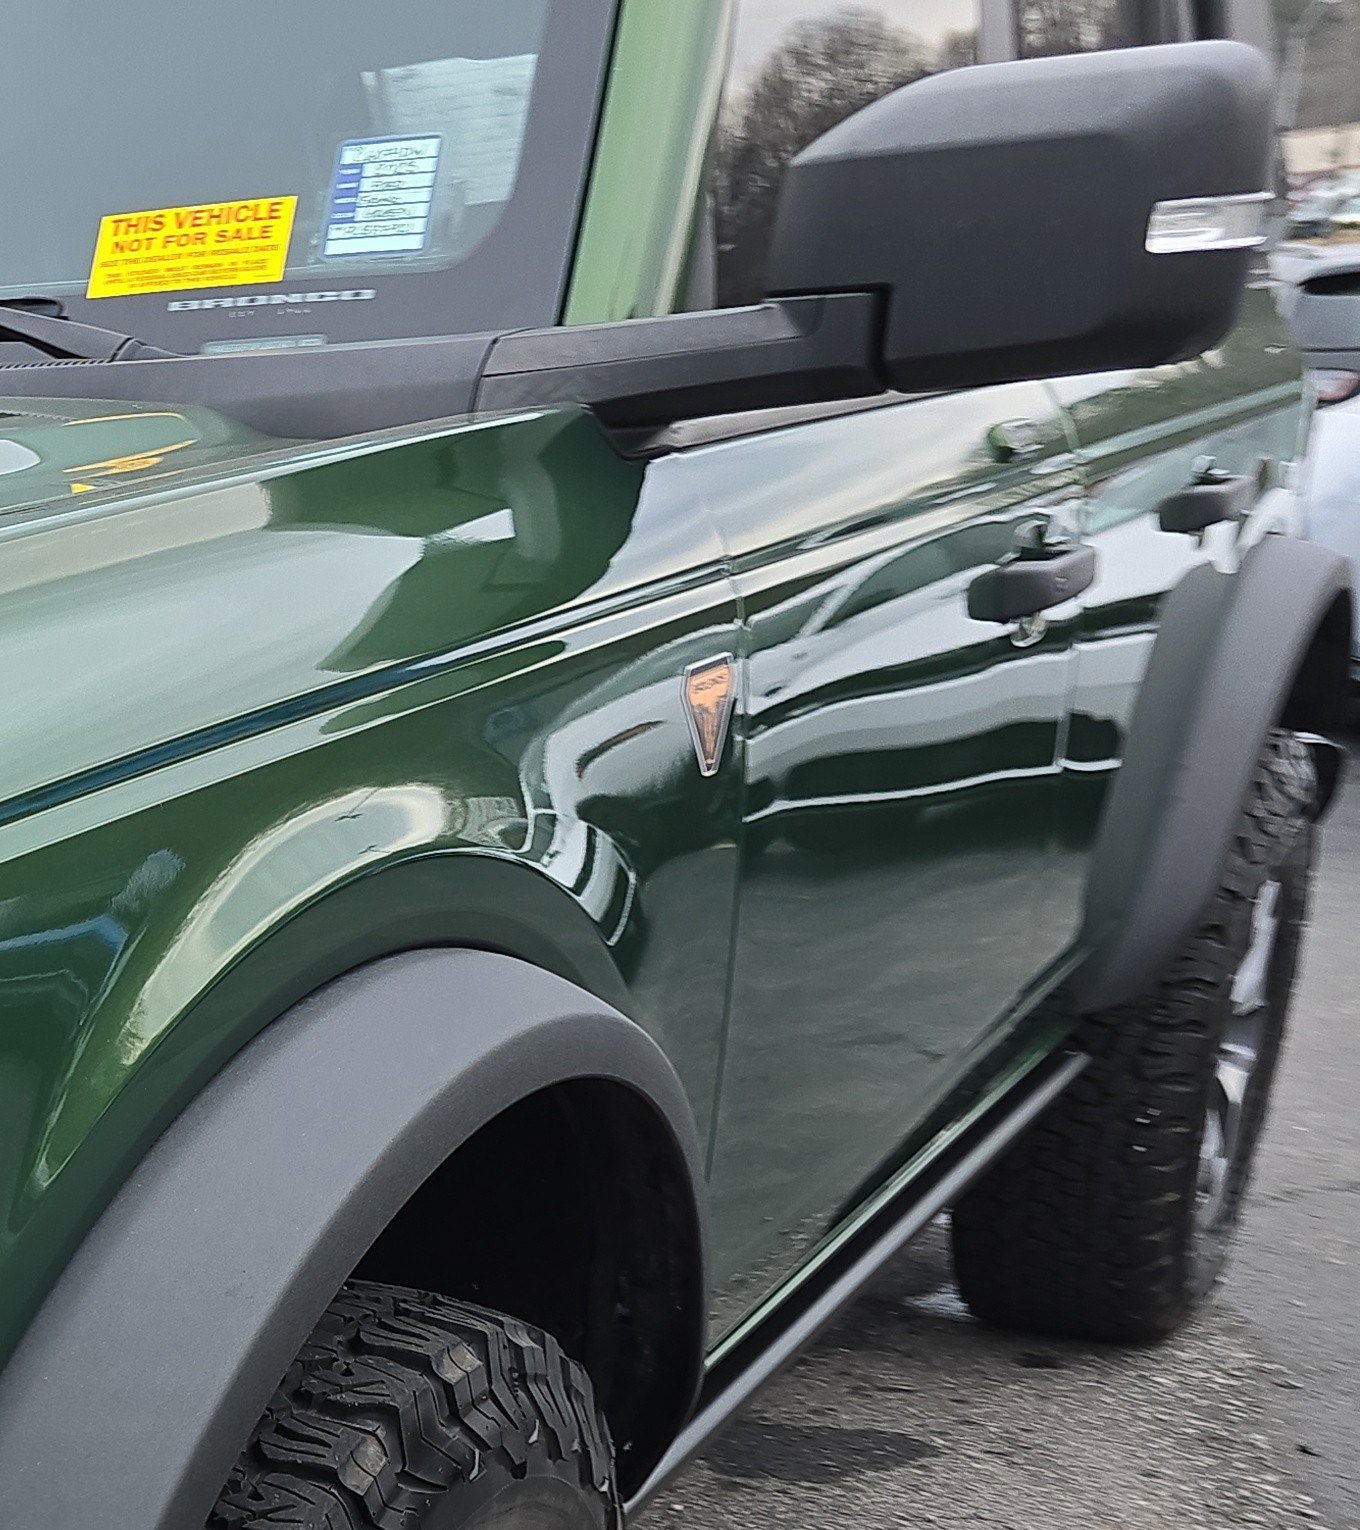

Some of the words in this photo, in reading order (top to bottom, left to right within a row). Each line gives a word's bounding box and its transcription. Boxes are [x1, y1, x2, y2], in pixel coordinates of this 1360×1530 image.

[113, 213, 165, 237] THIS
[174, 201, 283, 229] VEHICLE
[111, 236, 157, 254] NOT
[162, 231, 207, 249] FOR
[214, 225, 273, 244] SALE
[167, 288, 377, 312] BRONCO
